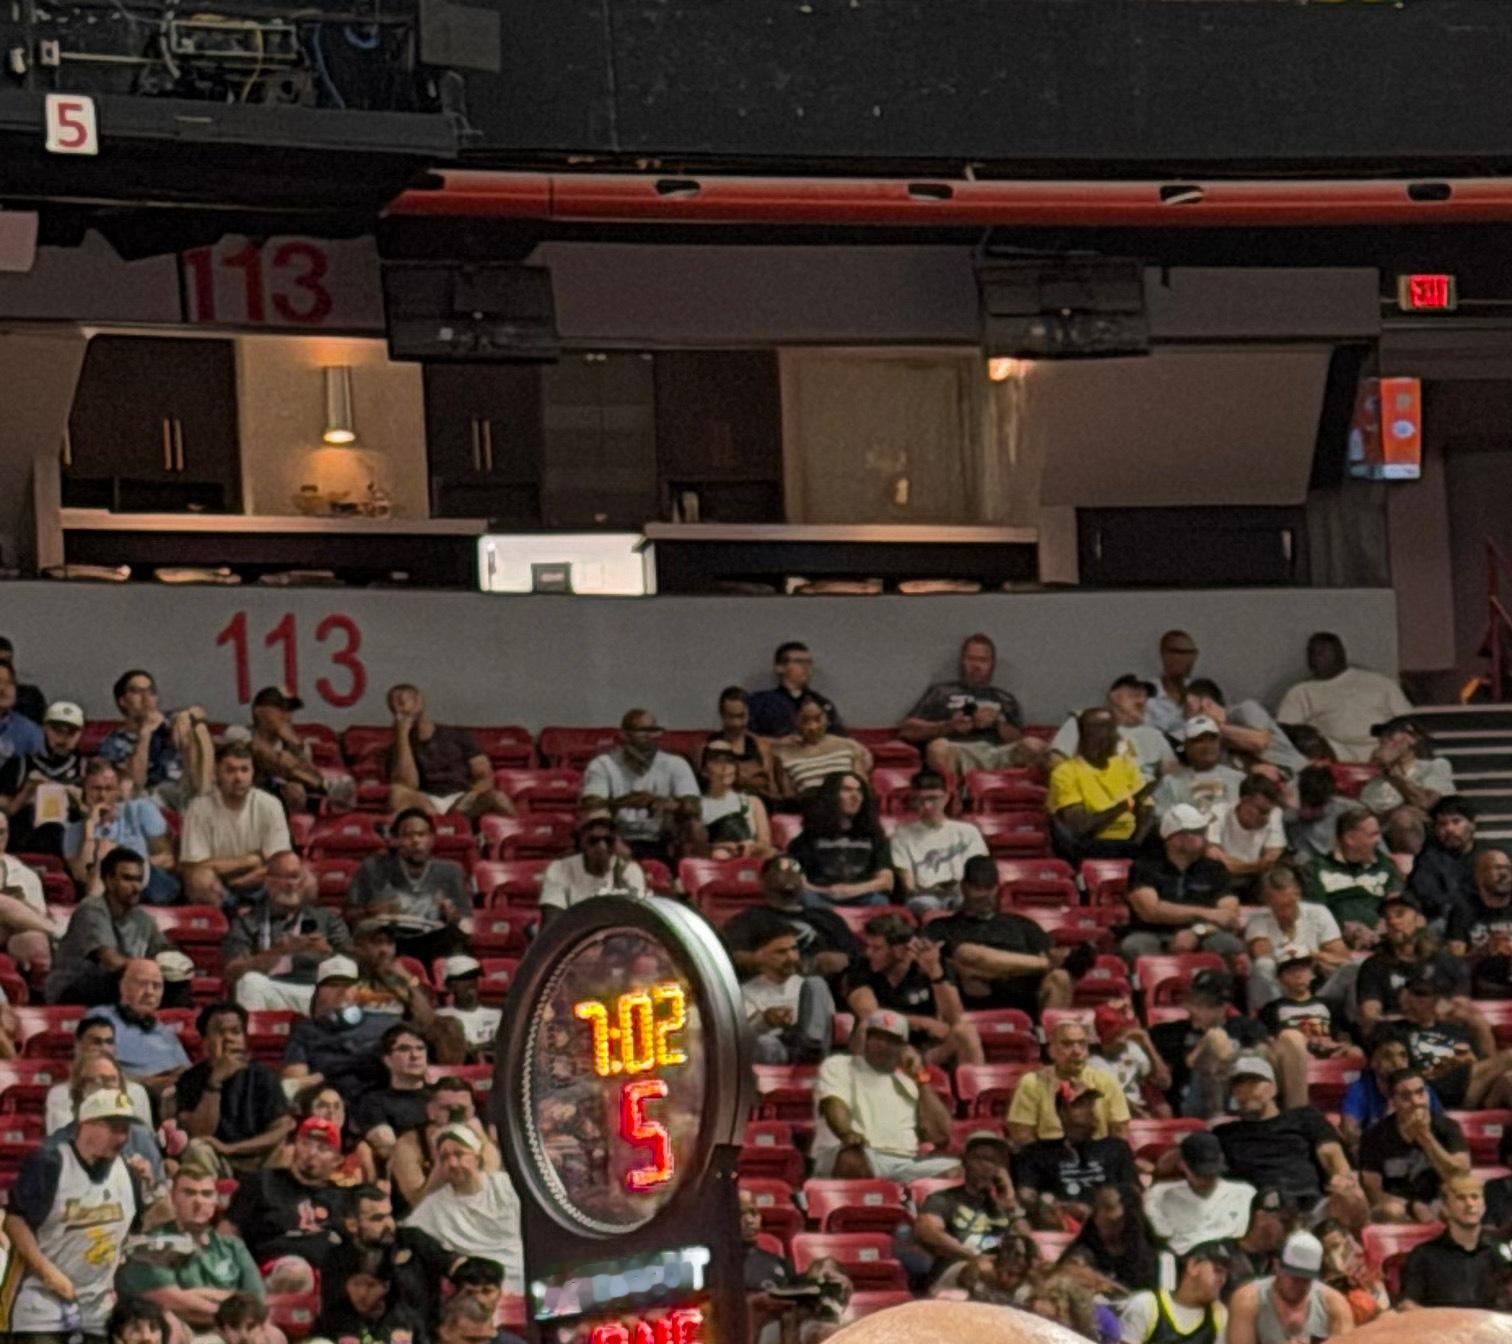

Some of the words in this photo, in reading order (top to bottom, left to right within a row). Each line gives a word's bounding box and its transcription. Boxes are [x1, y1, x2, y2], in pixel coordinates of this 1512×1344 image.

[57, 102, 88, 148] 5
[184, 240, 333, 324] 113
[216, 610, 368, 708] 113
[575, 980, 688, 1077] 7:02
[620, 1078, 675, 1192] 5
